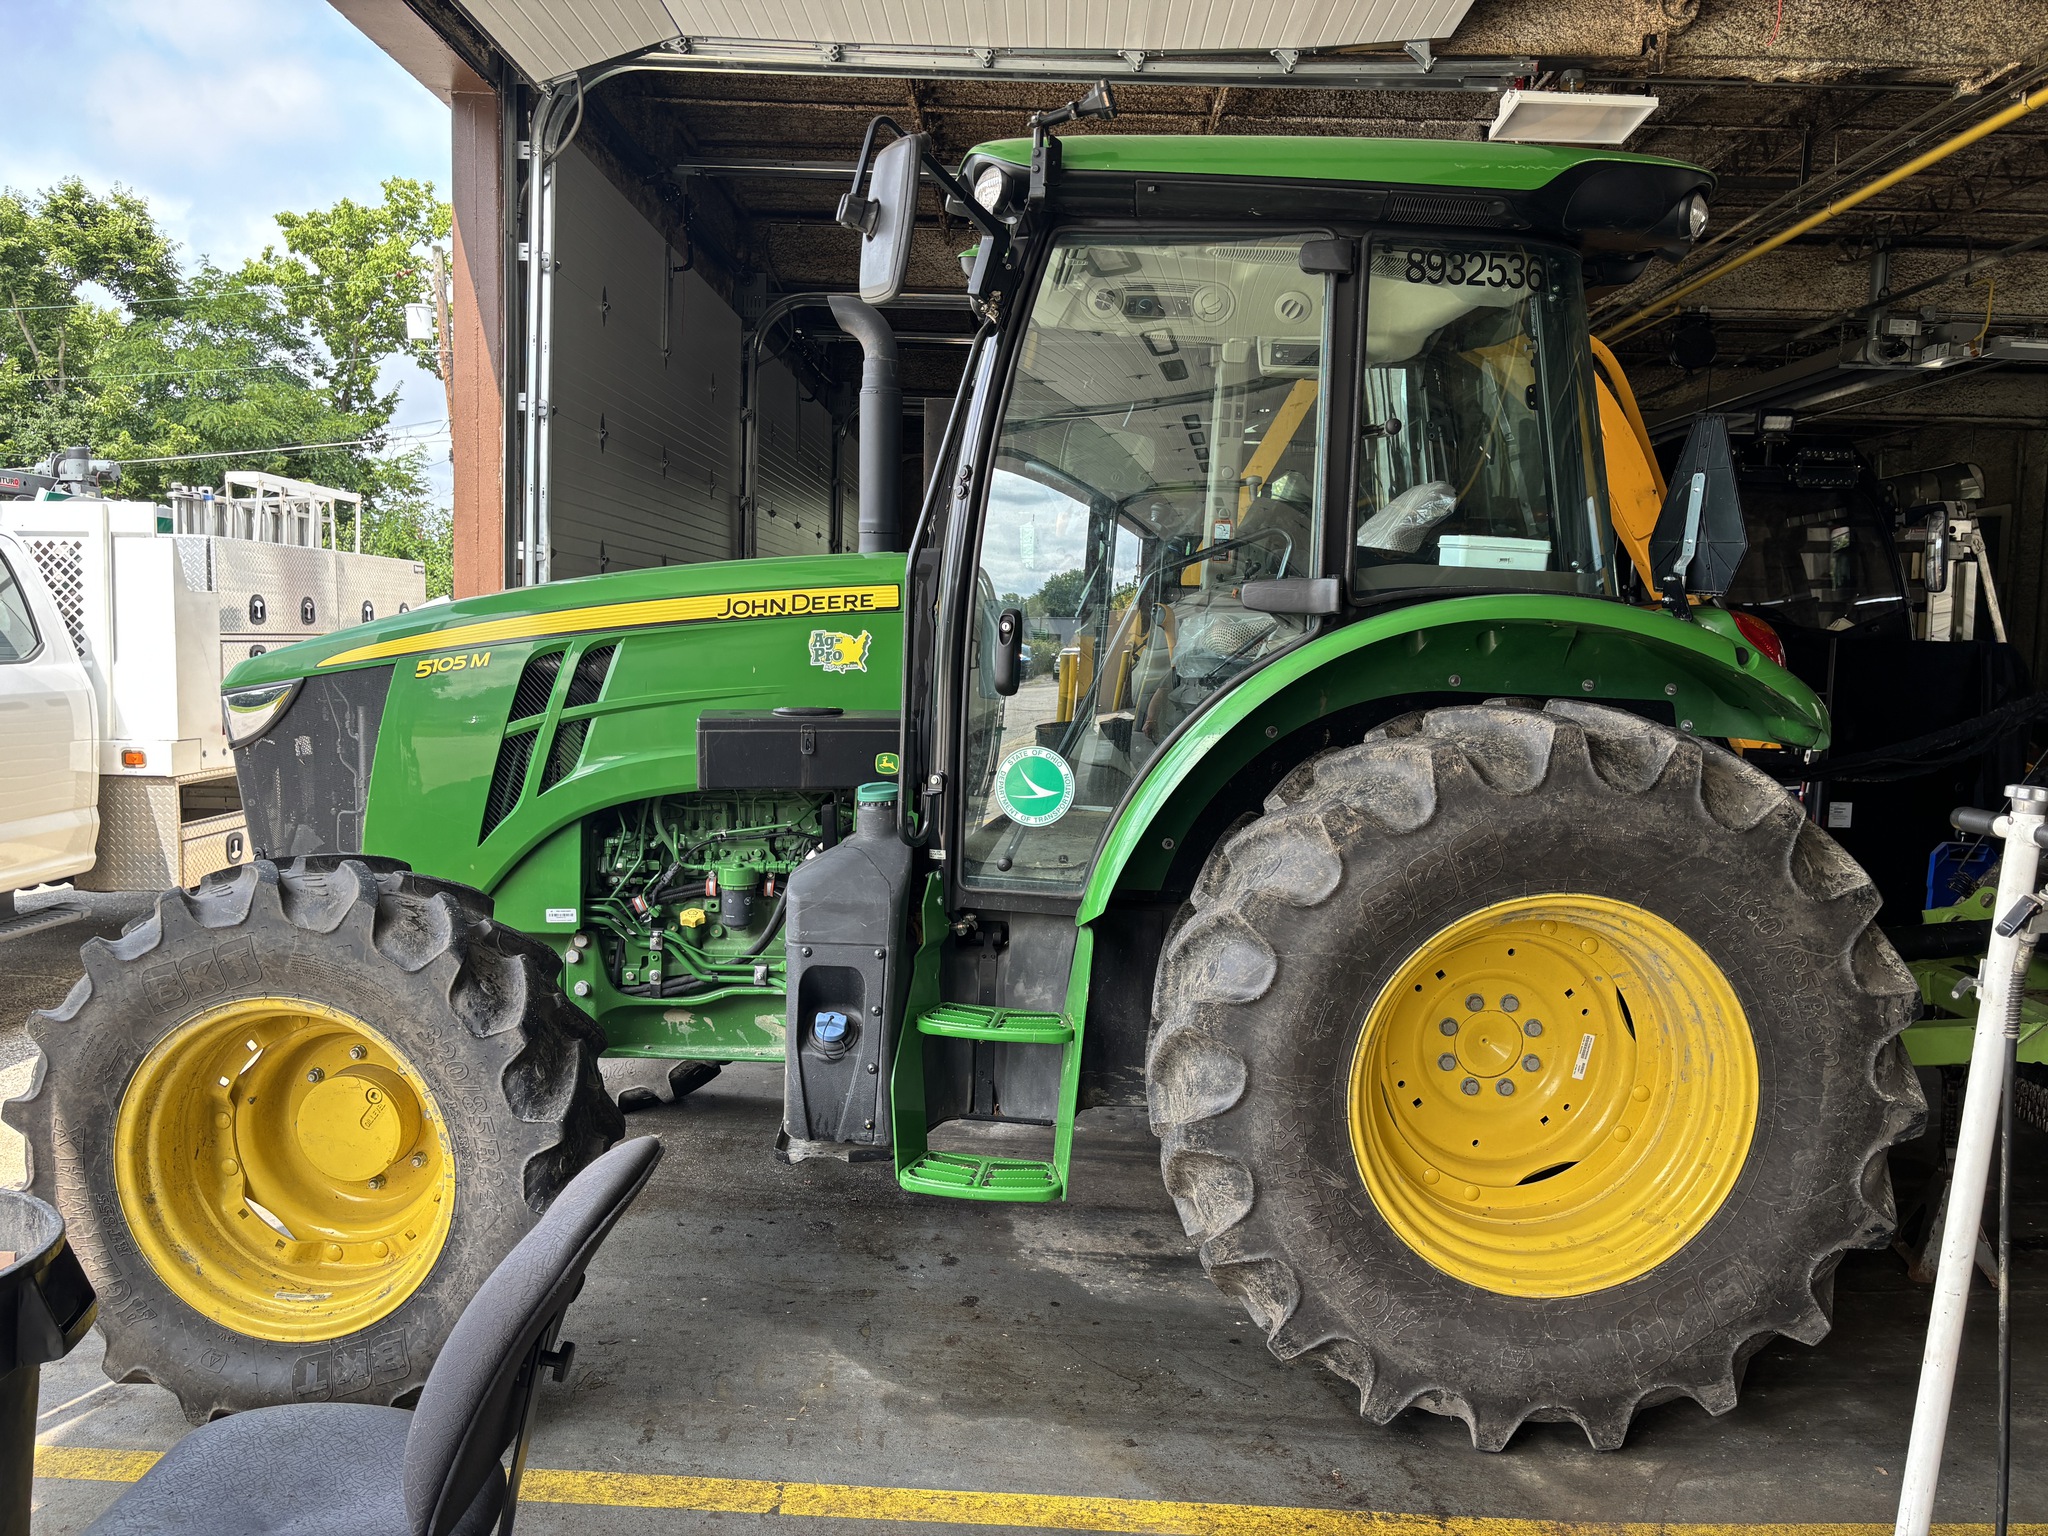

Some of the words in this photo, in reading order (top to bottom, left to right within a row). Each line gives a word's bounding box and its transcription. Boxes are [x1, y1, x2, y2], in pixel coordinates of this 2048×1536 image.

[1405, 248, 1544, 292] 8932536
[717, 598, 787, 617] JOHN
[791, 593, 874, 612] DEERE
[813, 632, 842, 650] Ag-
[414, 654, 468, 679] 5105
[470, 651, 491, 669] M
[813, 648, 843, 663] Pro
[1009, 751, 1028, 766] STATE
[1045, 752, 1063, 768] OHIO
[998, 771, 1018, 817] DEPARTMENT
[1035, 773, 1072, 822] TRANSPORTATION
[143, 939, 260, 1014] BKT
[293, 1331, 409, 1399] BKT
